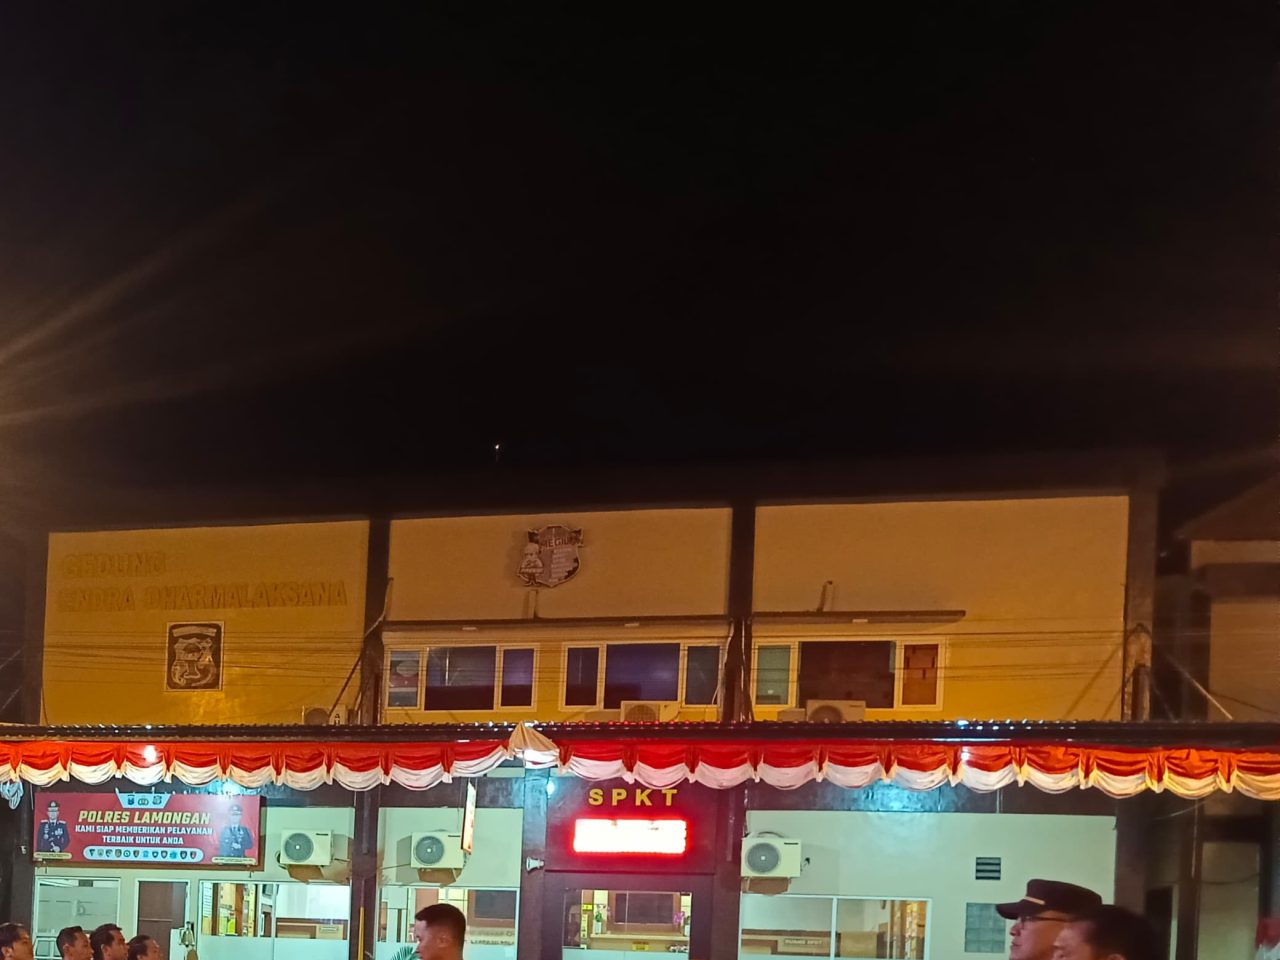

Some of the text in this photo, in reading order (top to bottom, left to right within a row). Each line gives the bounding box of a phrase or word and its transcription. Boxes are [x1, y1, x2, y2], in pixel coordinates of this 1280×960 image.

[588, 788, 678, 806] SPKT
[78, 810, 211, 825] POLRES LAMONGAN
[75, 825, 213, 836] KAMI SIAP MEMBERIKAN PELAYANAN
[102, 835, 184, 845] TERBAIK UNTUK ANDA
